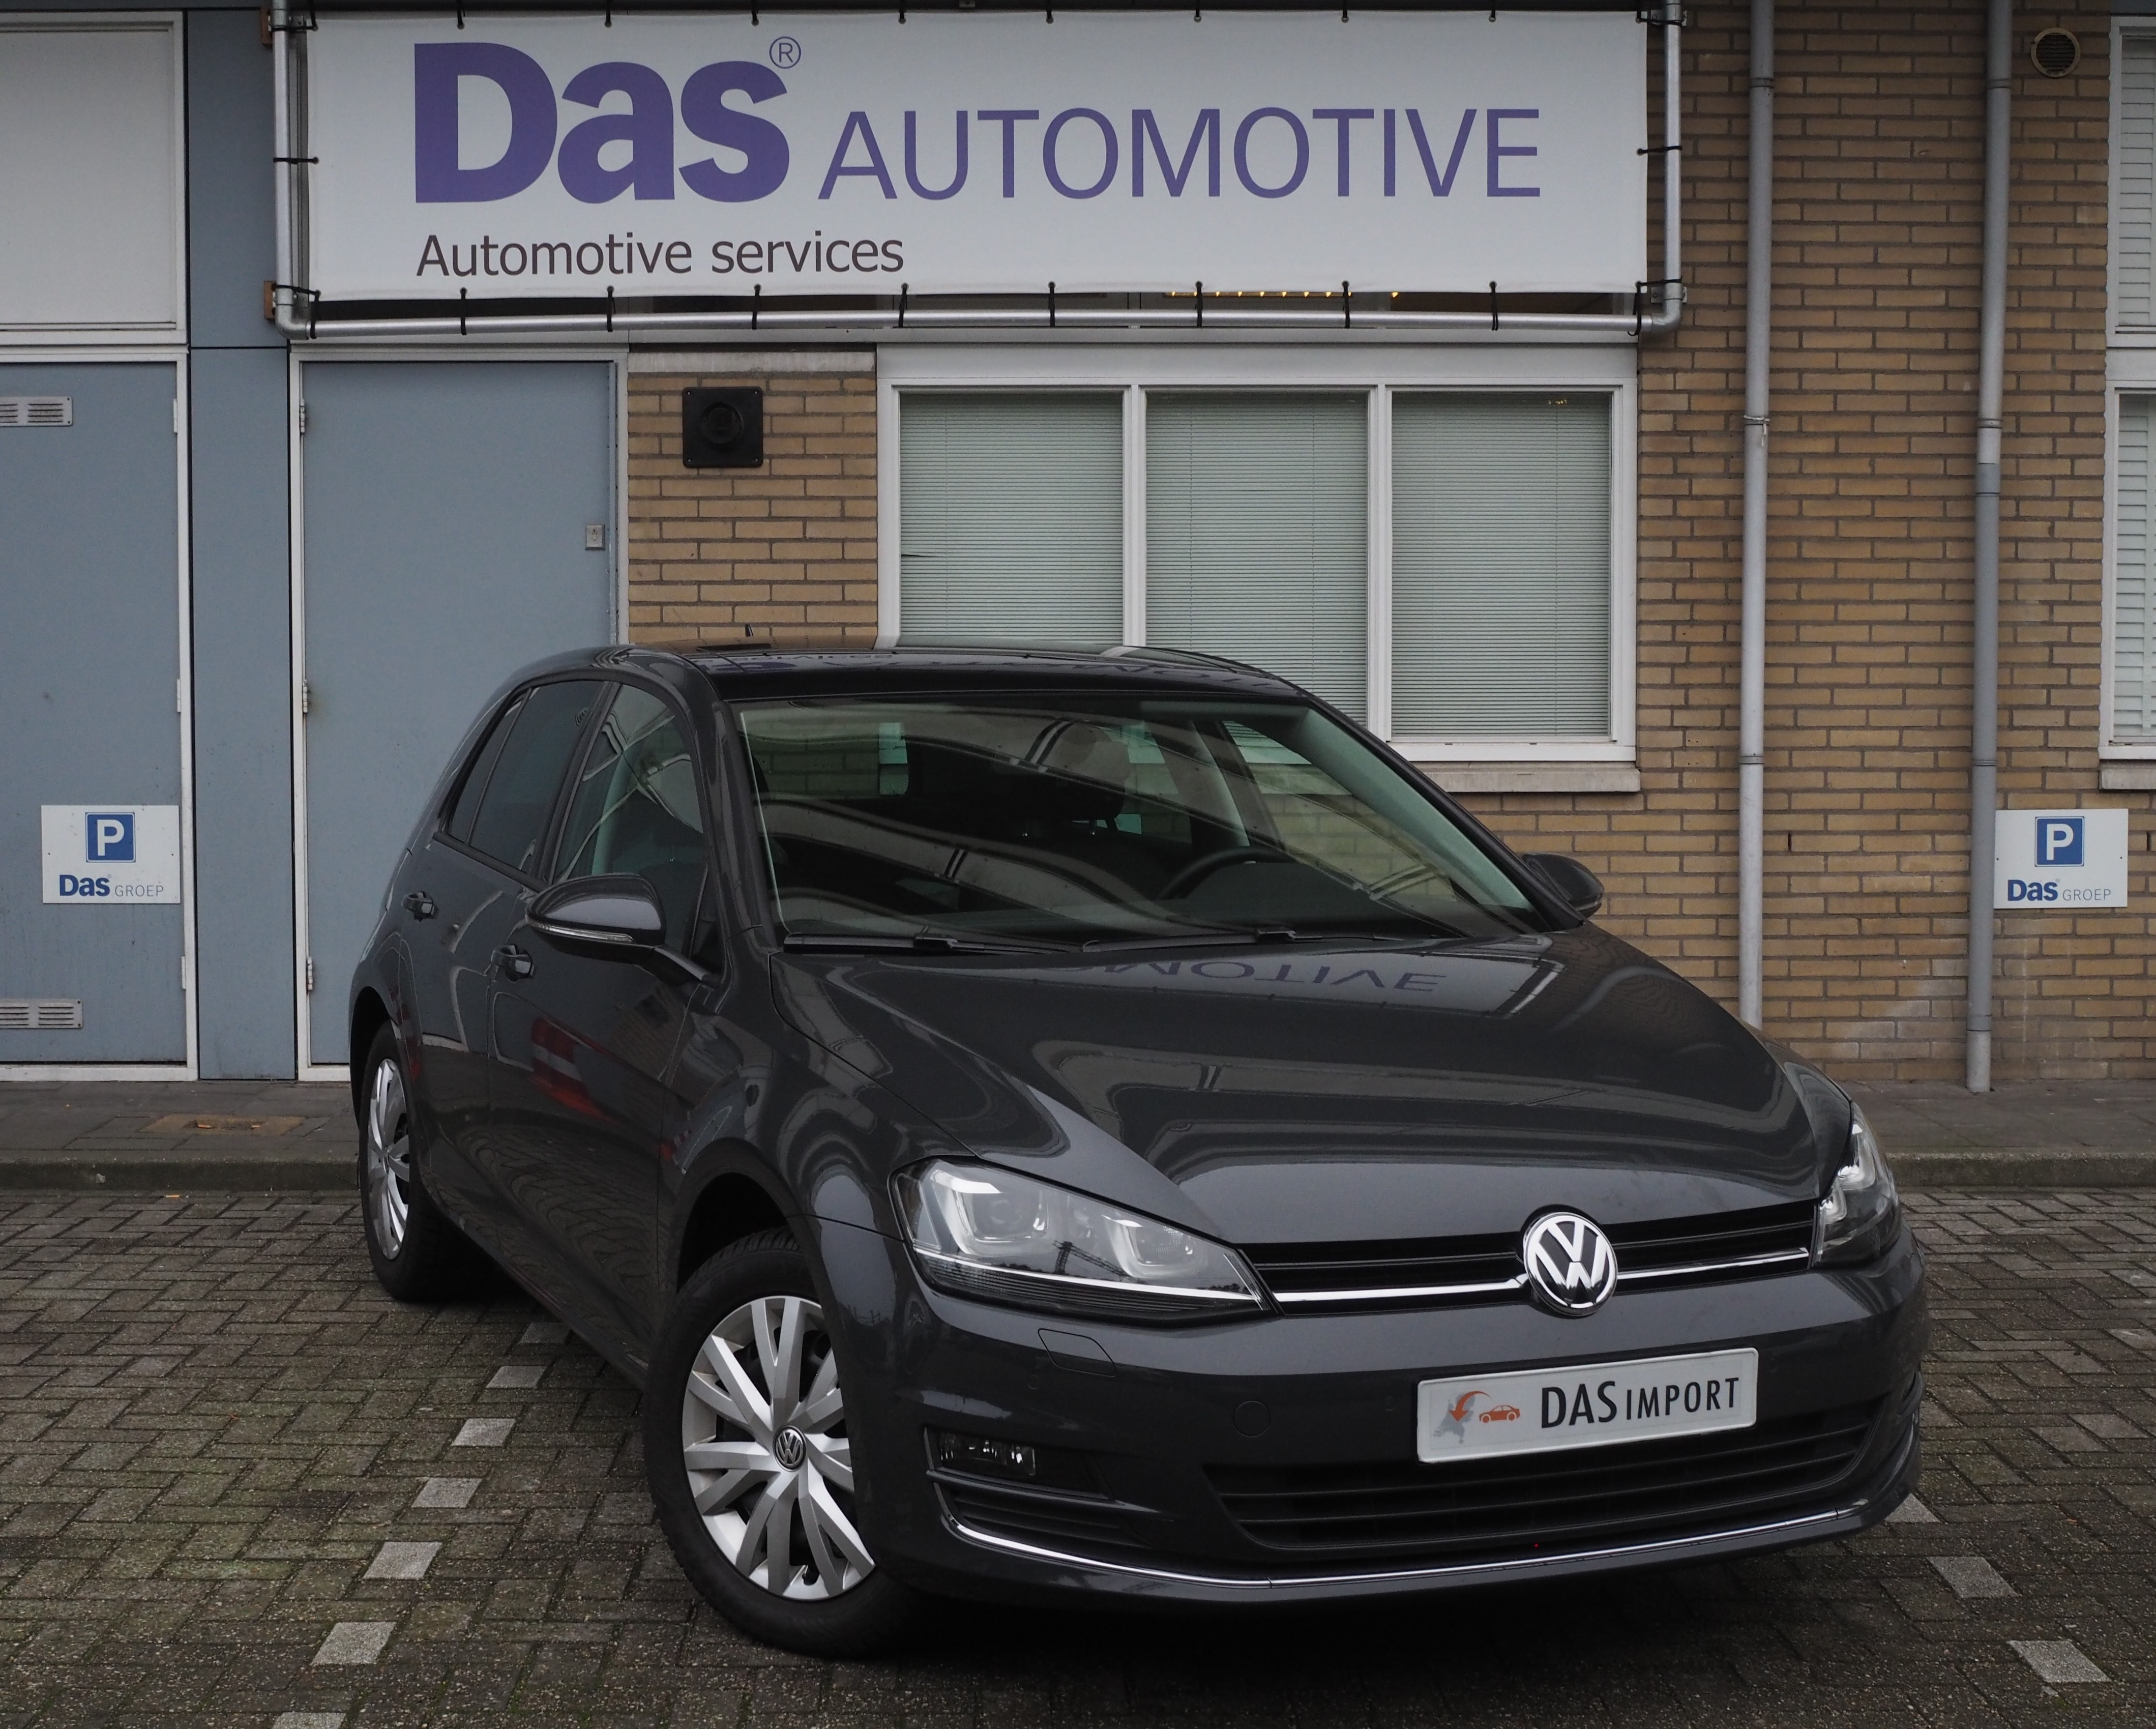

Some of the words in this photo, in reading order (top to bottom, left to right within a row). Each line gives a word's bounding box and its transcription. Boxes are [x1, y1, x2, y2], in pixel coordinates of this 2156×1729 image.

[819, 105, 1541, 200] AUTOMOTIVE
[417, 232, 692, 276] Automotive
[712, 230, 904, 274] services
[97, 819, 125, 856] P
[2046, 824, 2074, 860] P
[60, 875, 110, 896] Das
[115, 885, 164, 897] GROEP
[2007, 880, 2058, 901] Das
[2062, 889, 2111, 901] GROEP
[1541, 1381, 1617, 1428] DAS
[1627, 1377, 1739, 1420] IMPORT
